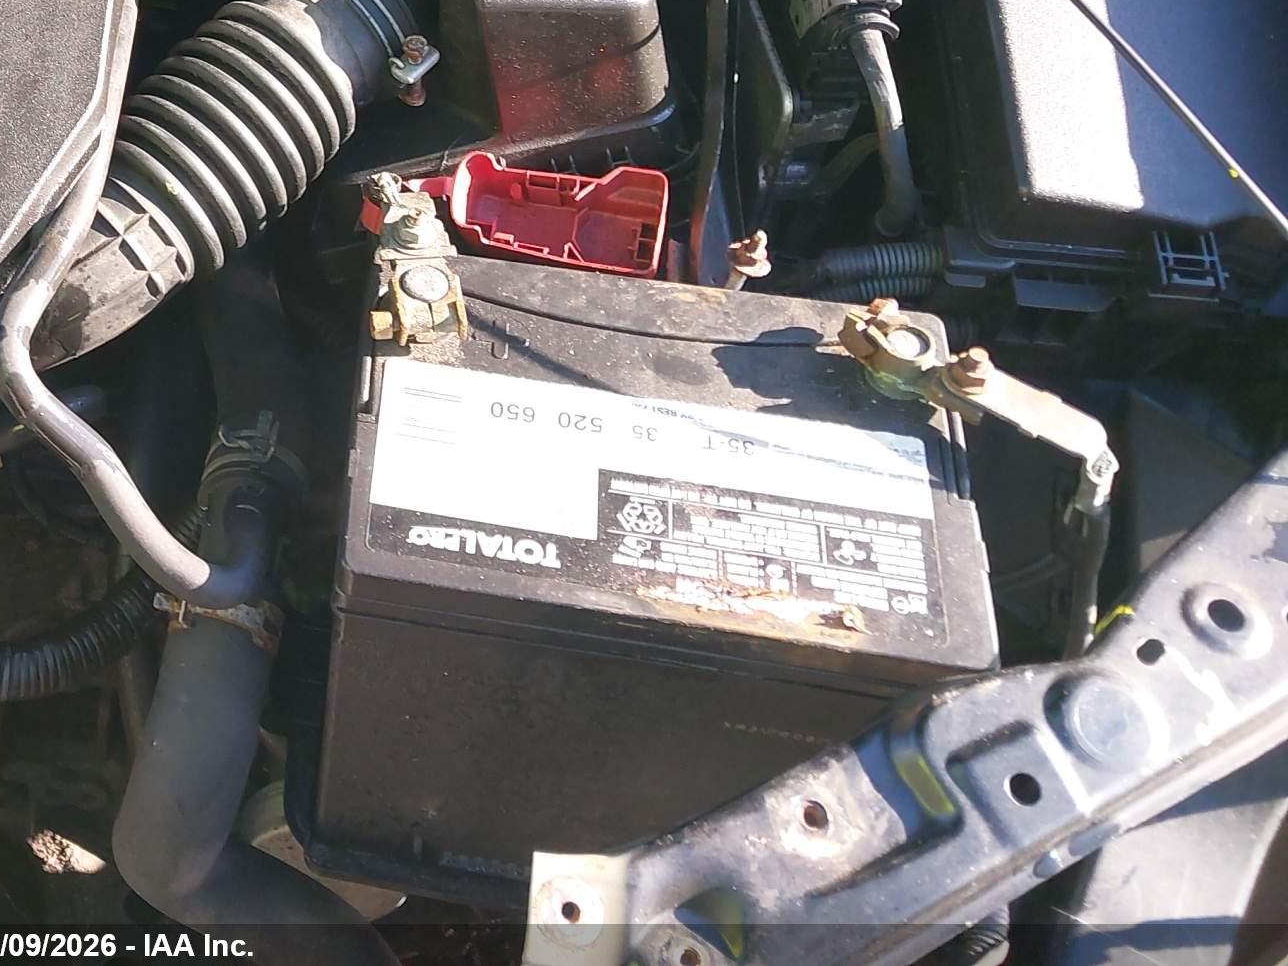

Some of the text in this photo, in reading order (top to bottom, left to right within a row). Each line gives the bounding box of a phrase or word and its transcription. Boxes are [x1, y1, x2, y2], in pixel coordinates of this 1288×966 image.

[490, 400, 755, 456] 35-T 35 520 650
[405, 525, 562, 569] TOTALPRO
